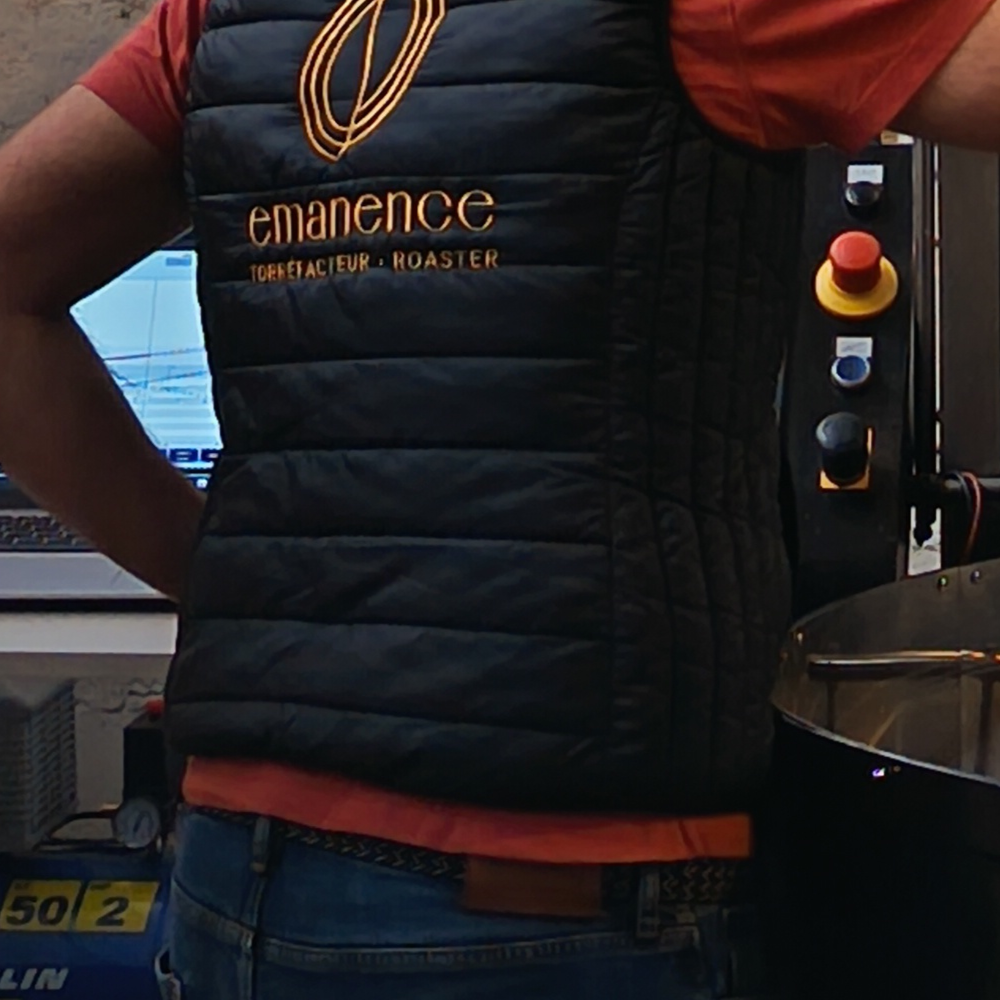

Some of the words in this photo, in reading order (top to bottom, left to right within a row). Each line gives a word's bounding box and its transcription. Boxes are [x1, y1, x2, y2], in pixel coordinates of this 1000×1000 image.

[249, 189, 495, 247] emanence
[392, 249, 499, 273] ROASTER
[6, 895, 69, 926] 50
[95, 896, 130, 927] 2
